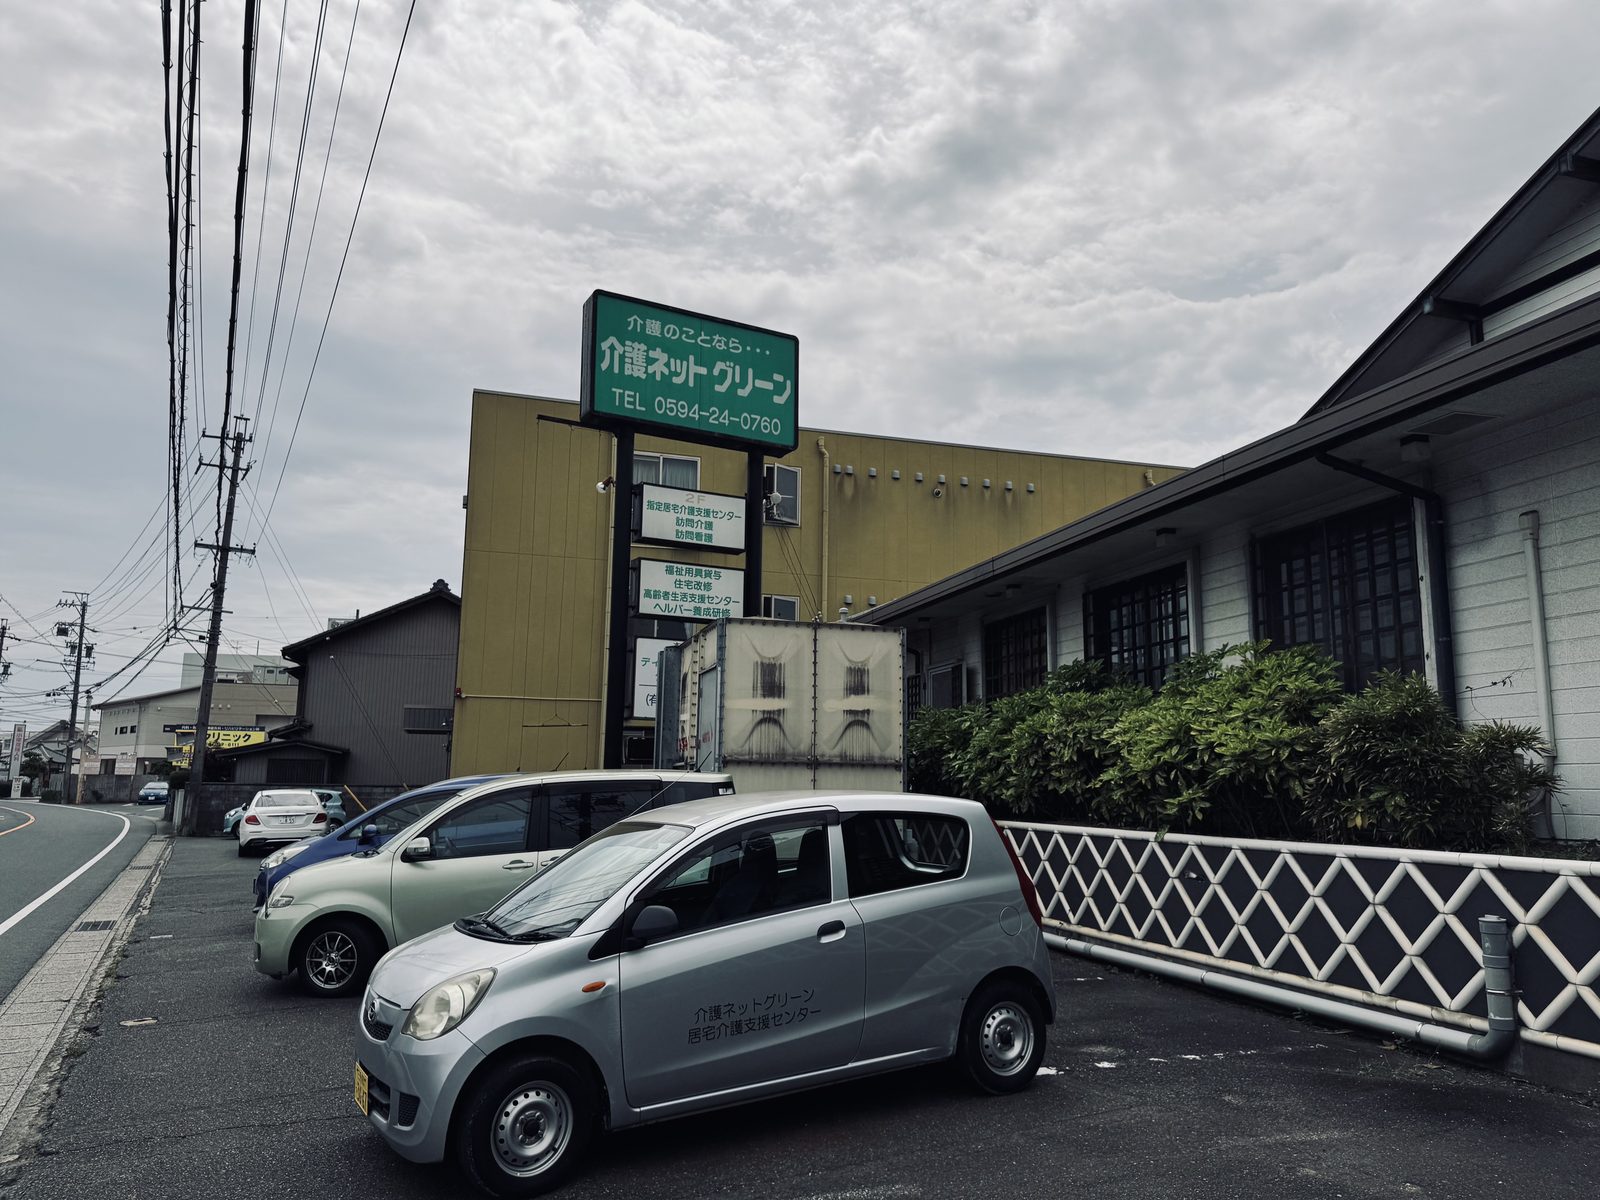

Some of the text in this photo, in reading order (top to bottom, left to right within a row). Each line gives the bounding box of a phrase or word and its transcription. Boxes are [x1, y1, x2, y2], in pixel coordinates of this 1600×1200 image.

[601, 336, 791, 404] 介護ネットグリーン
[612, 388, 781, 436] TEL 0594-24-0760
[685, 493, 706, 505] 2F
[646, 499, 742, 520] 指定居宅介護支援センター
[675, 516, 713, 531] 訪問介護
[675, 529, 713, 543] 訪問看護
[665, 564, 722, 580] 福祉用具貸与
[674, 578, 713, 591] 住宅改修
[643, 588, 740, 606] 高齢者生活支援センター
[694, 988, 815, 1024] 介護ネットグリーン
[688, 1007, 821, 1044] 居宅介護支援センター
